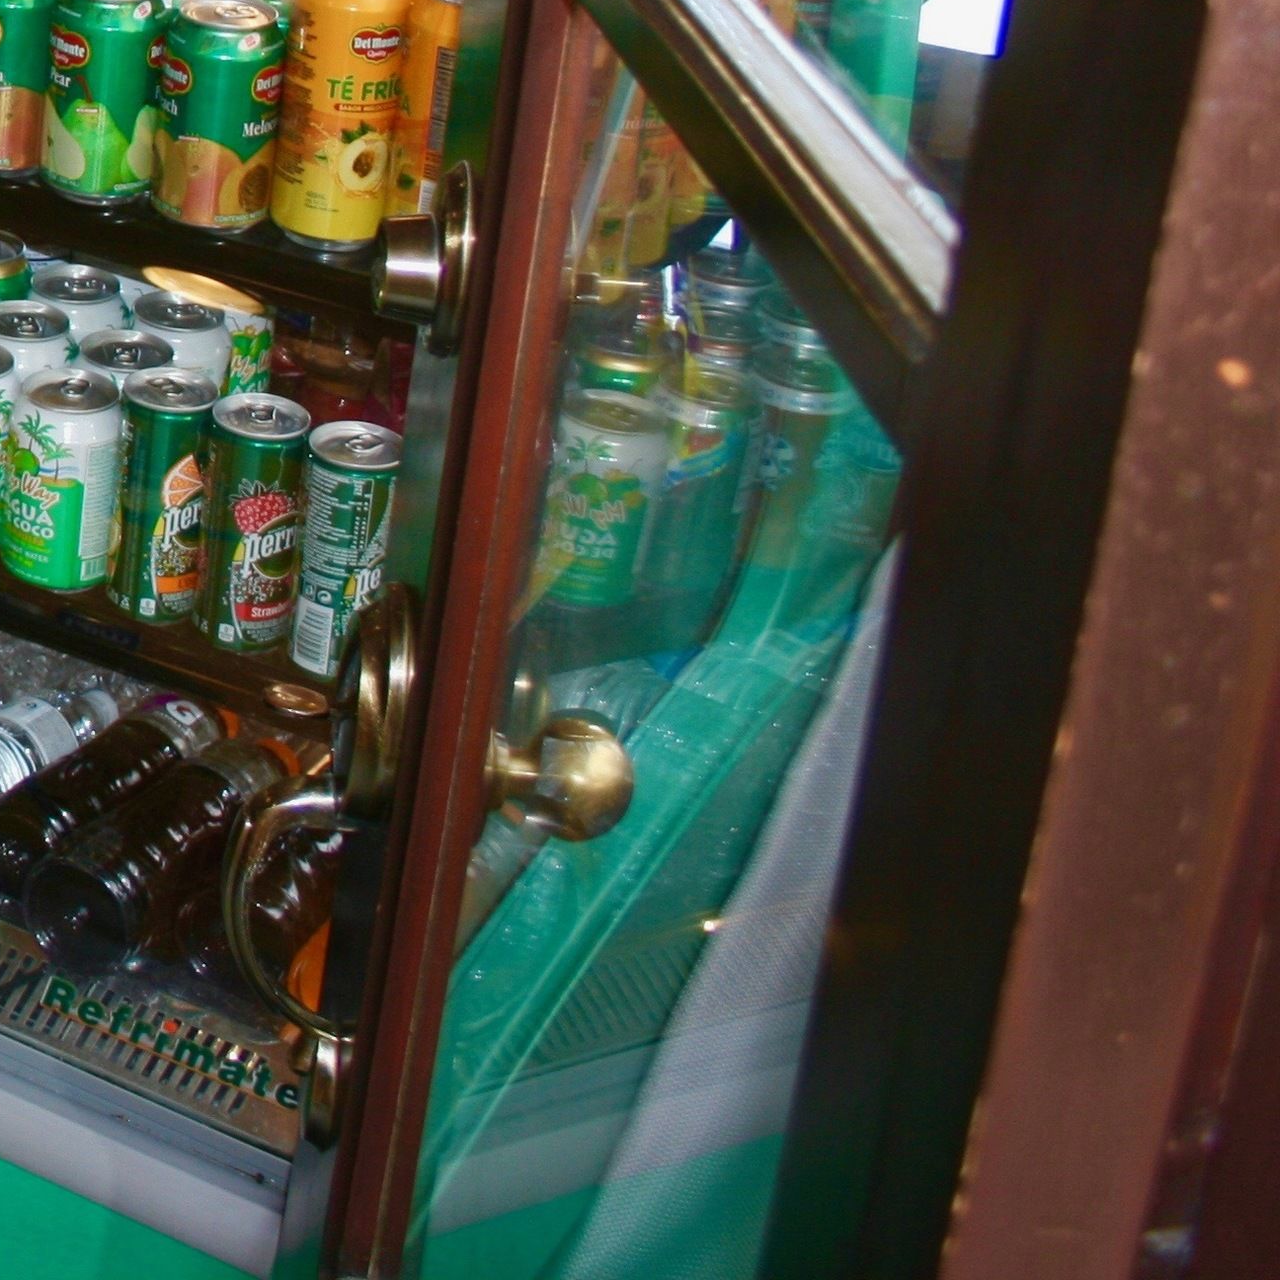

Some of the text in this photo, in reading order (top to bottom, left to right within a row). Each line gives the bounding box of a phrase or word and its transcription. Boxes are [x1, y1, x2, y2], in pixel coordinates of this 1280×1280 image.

[353, 35, 400, 49] Del Monte
[326, 75, 355, 101] TÉ
[9, 498, 55, 527] GUA
[13, 516, 56, 539] COCO
